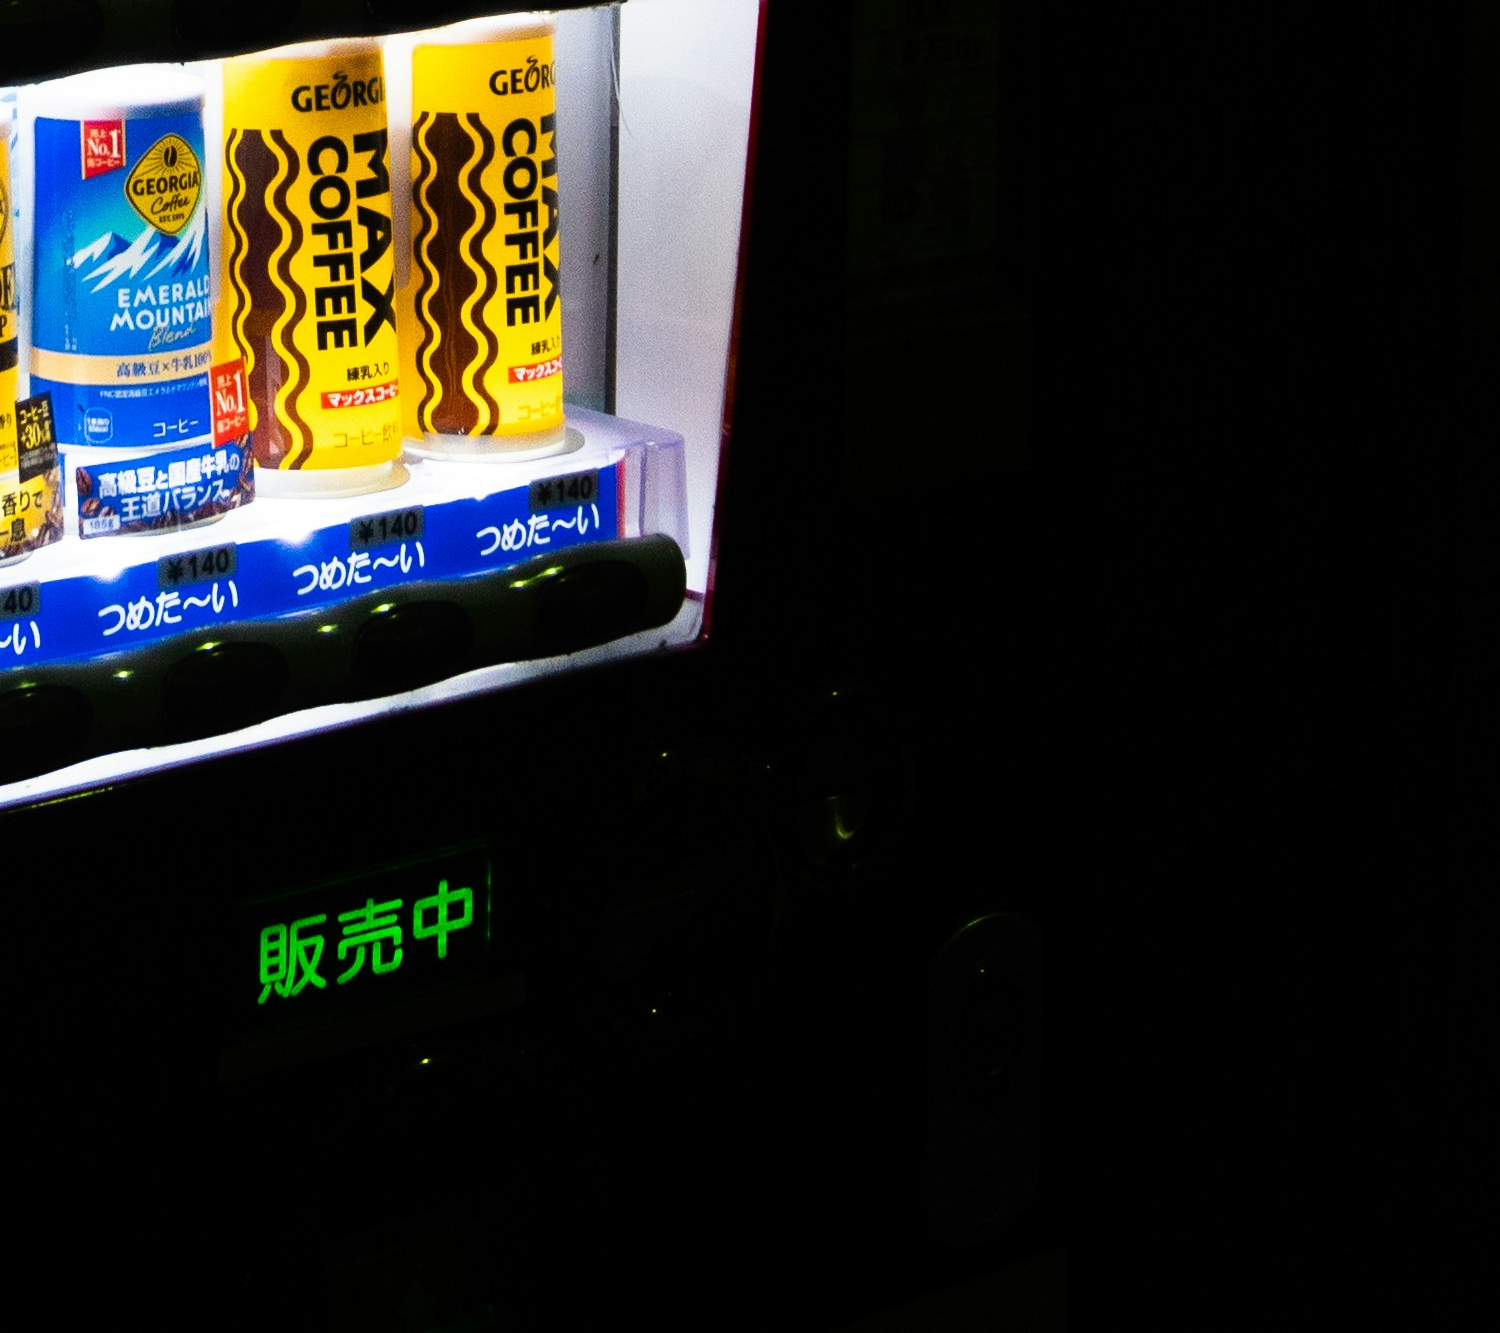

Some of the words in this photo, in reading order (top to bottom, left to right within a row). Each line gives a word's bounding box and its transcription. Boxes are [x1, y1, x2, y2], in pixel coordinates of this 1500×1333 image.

[307, 135, 358, 351] COFFEE
[354, 129, 396, 348] MAX
[347, 362, 390, 383] 練乳入り
[216, 385, 245, 418] No.1
[99, 451, 240, 496] 高級豆と国産牛乳の
[167, 547, 232, 584] ¥140
[258, 879, 473, 1004] 販売中
